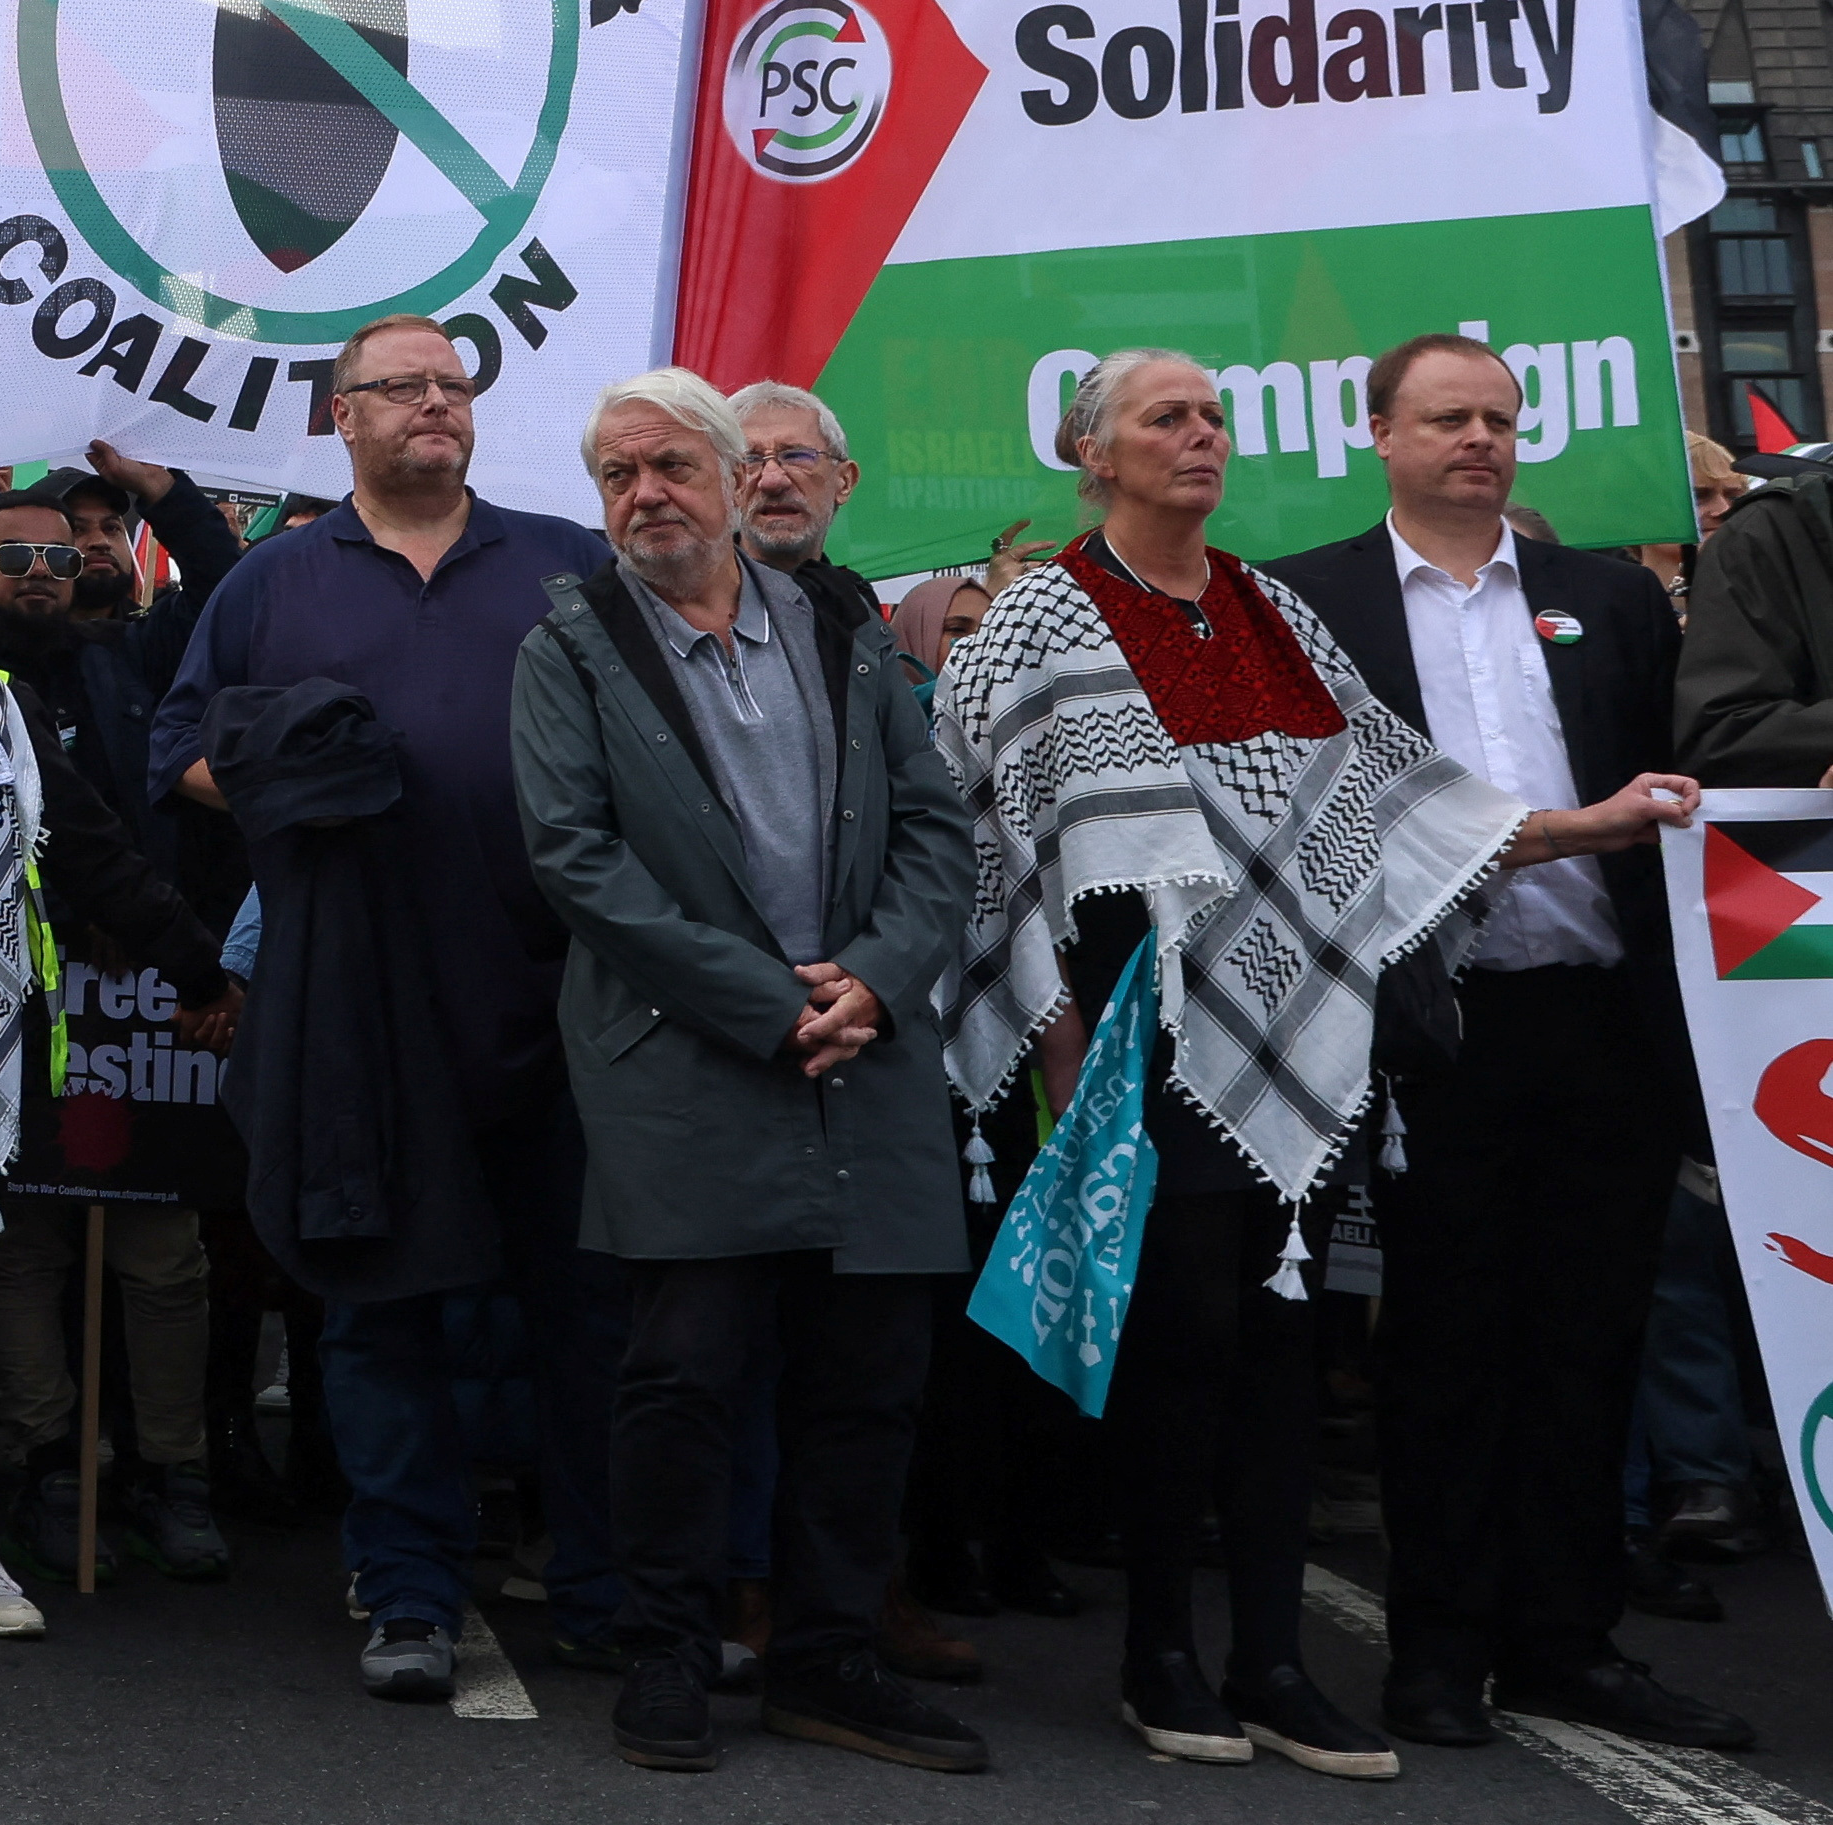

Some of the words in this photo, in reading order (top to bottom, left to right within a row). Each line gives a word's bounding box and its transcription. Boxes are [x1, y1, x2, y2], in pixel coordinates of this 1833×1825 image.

[759, 57, 857, 118] PSC
[1027, 321, 1639, 478] Cmpgn
[7, 1182, 23, 1194] Stop
[25, 1183, 38, 1193] the
[40, 1184, 56, 1195] War
[58, 1185, 97, 1197] Coalition
